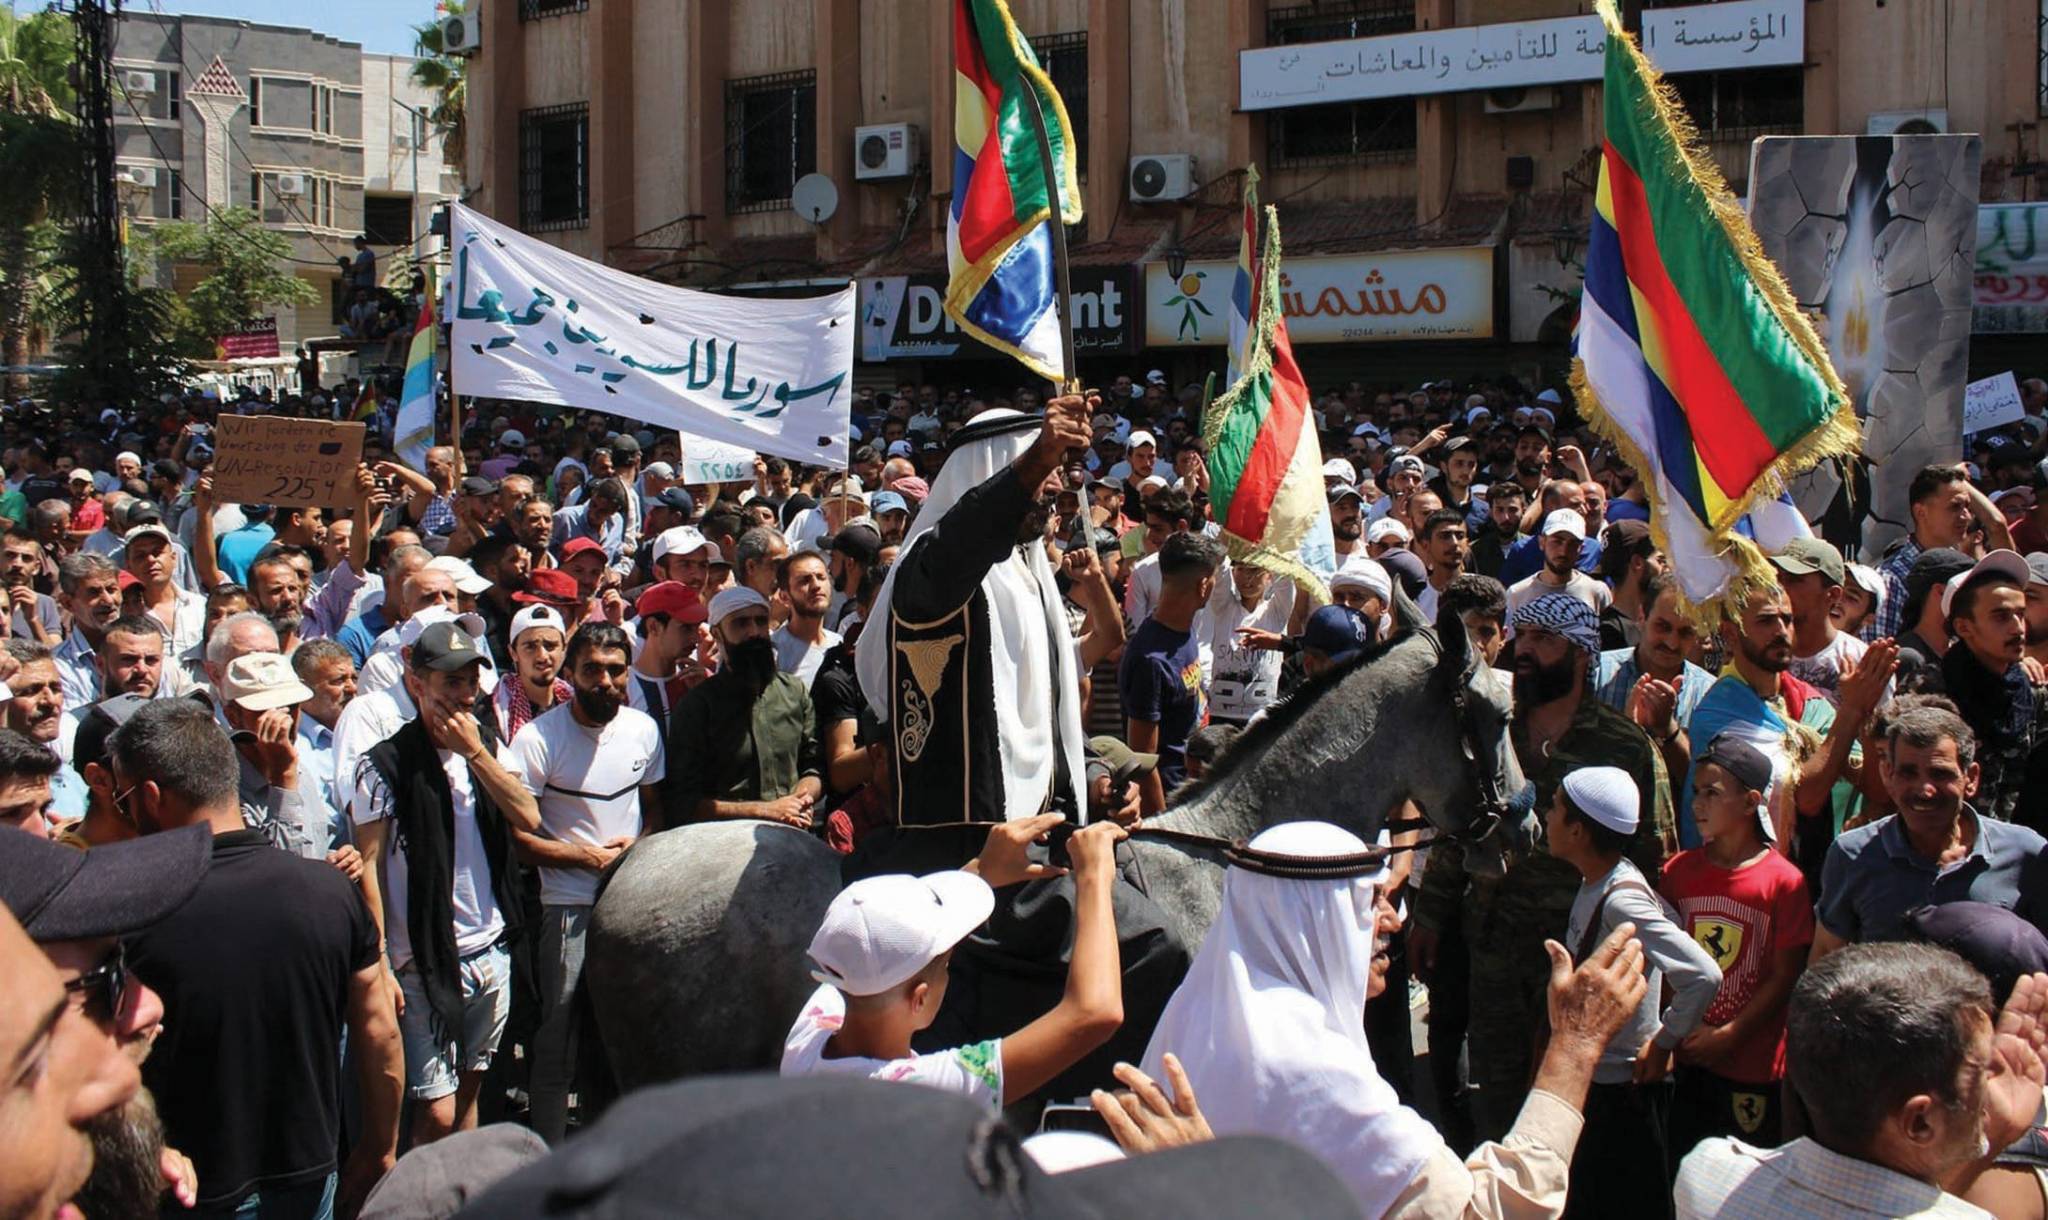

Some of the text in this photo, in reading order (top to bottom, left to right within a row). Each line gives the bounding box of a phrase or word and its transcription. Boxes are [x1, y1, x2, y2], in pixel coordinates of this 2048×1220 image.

[1466, 28, 1557, 72] للتأمين
[1674, 13, 1787, 53] المؤسسة
[1325, 46, 1450, 79] والمعاشات
[723, 341, 848, 422] سوريا
[263, 477, 336, 501] 2254
